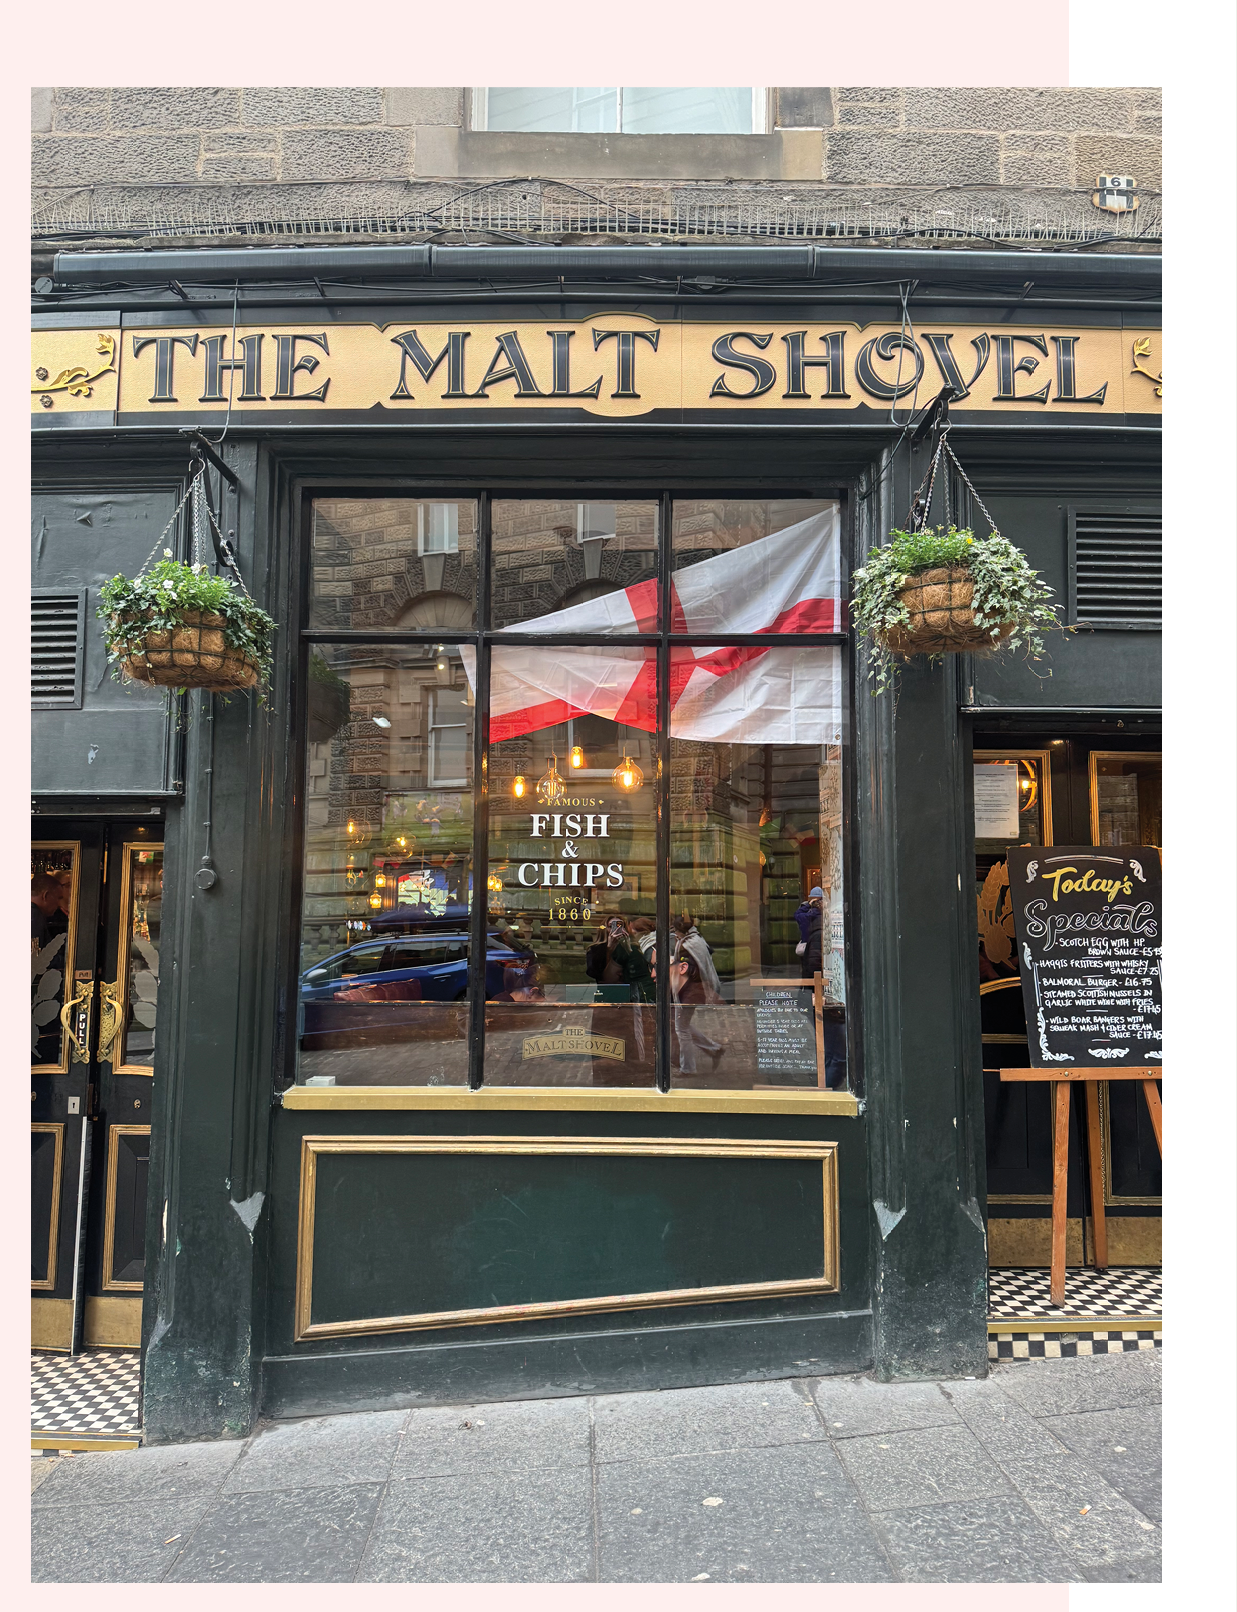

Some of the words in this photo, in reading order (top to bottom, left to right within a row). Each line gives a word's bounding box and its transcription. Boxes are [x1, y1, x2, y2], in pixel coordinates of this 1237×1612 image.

[1110, 176, 1122, 187] 6
[131, 331, 332, 403] THE
[389, 327, 661, 401] MALT
[708, 329, 1109, 405] SHOVEL
[546, 798, 596, 807] FAMOUS
[530, 813, 610, 838] FISH
[561, 840, 579, 858] &
[518, 862, 623, 888] CHIPS
[1041, 866, 1134, 903] Today's
[554, 896, 589, 906] SINCE
[548, 907, 591, 920] 1860
[1023, 898, 1158, 952] Specials
[1059, 938, 1089, 947] SCOTCH
[1090, 937, 1109, 949] EGG
[1111, 938, 1129, 947] WITH
[1087, 948, 1112, 956] BROWN
[1039, 960, 1068, 969] HAGGIS
[1070, 960, 1103, 969] FRITTERS
[1103, 960, 1120, 968] WITH
[1121, 960, 1149, 968] WHISKY
[1044, 990, 1077, 999] STEAMED
[1077, 989, 1109, 998] SCOTTISH
[1143, 989, 1153, 997] IN
[1044, 999, 1072, 1009] GARLIC
[1074, 998, 1097, 1006] WHITE
[1132, 998, 1154, 1007] FRIES
[1049, 1015, 1069, 1024] WILD
[1070, 1016, 1092, 1024] BOAR
[1126, 1015, 1145, 1024] WITH
[78, 1013, 87, 1044] PULL
[1127, 1022, 1153, 1031] CREAM
[565, 1028, 584, 1037] THE
[1108, 1031, 1131, 1039] SAUCE
